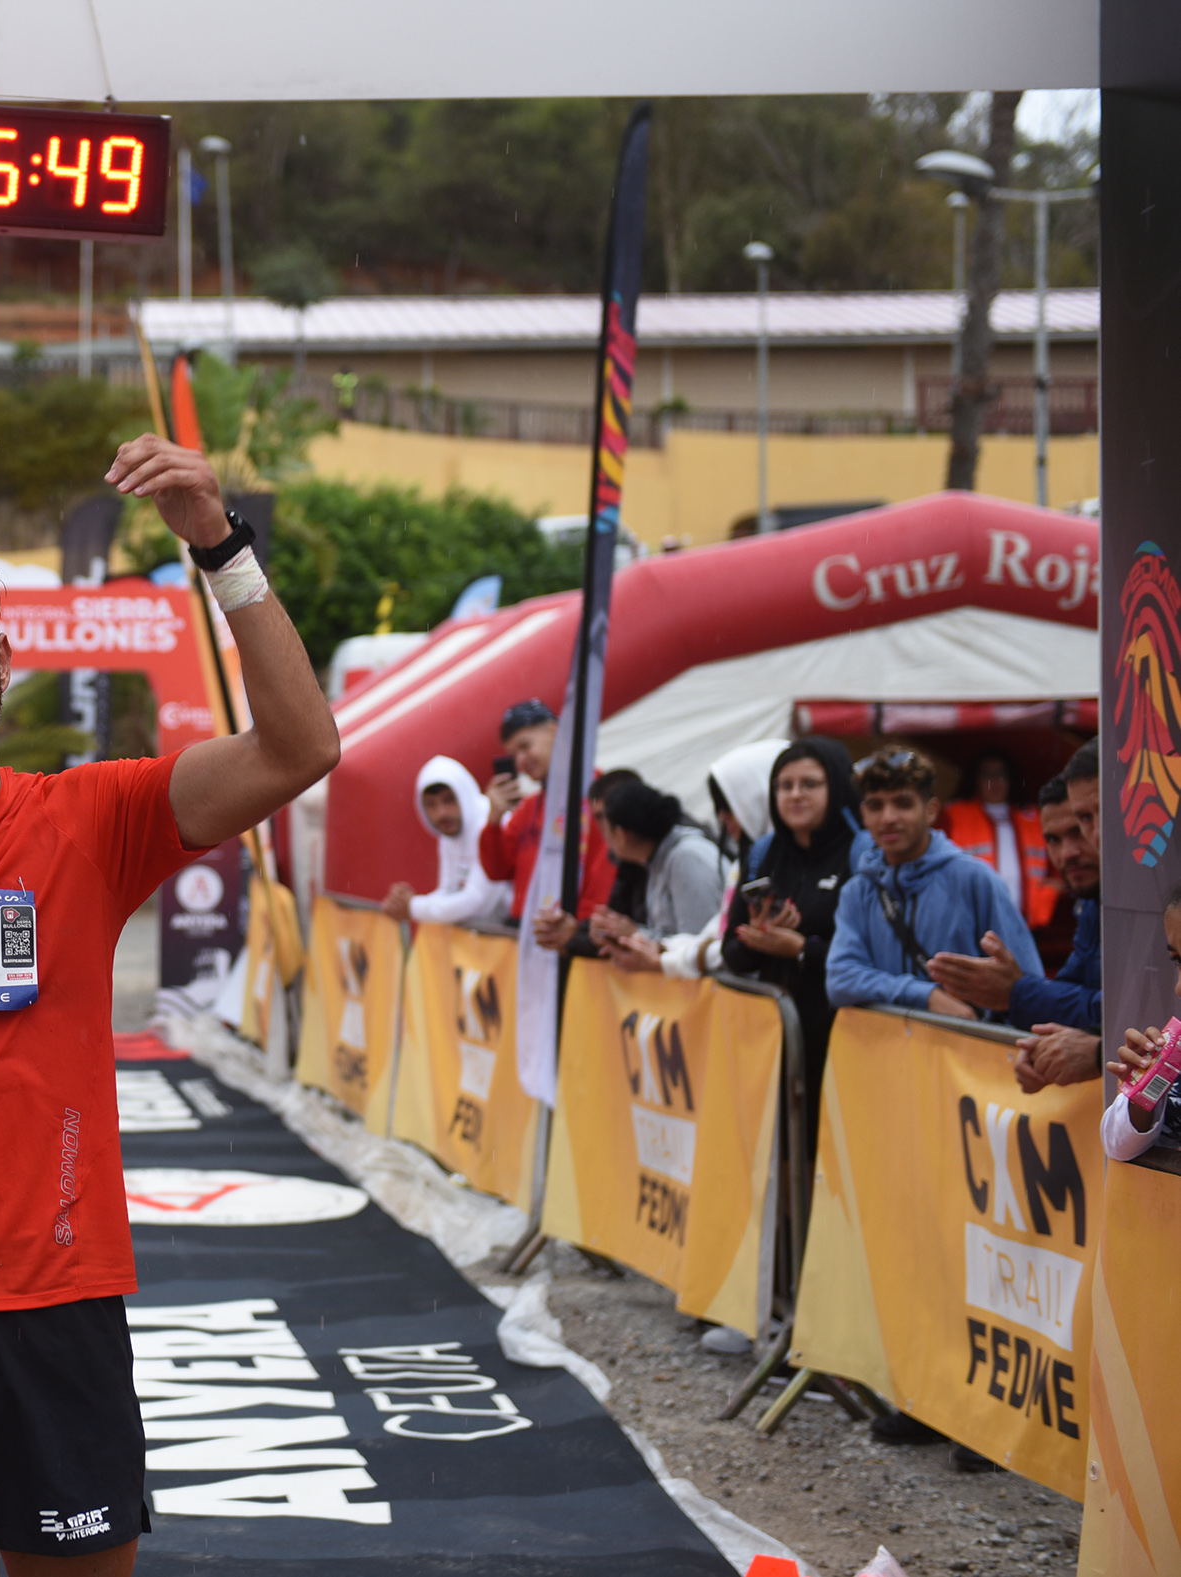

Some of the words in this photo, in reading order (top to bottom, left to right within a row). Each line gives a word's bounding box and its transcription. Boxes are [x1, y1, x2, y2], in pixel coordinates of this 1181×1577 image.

[72, 597, 174, 619] SIERRA
[812, 551, 964, 612] Cruz
[984, 528, 1100, 611] Roj
[621, 1009, 696, 1114] CXM
[55, 1106, 82, 1247] SALOMON
[958, 1095, 1087, 1248] CXM
[983, 1242, 1064, 1329] TRAIL
[338, 1341, 533, 1441] CEUTA
[966, 1316, 1081, 1441] FEDME
